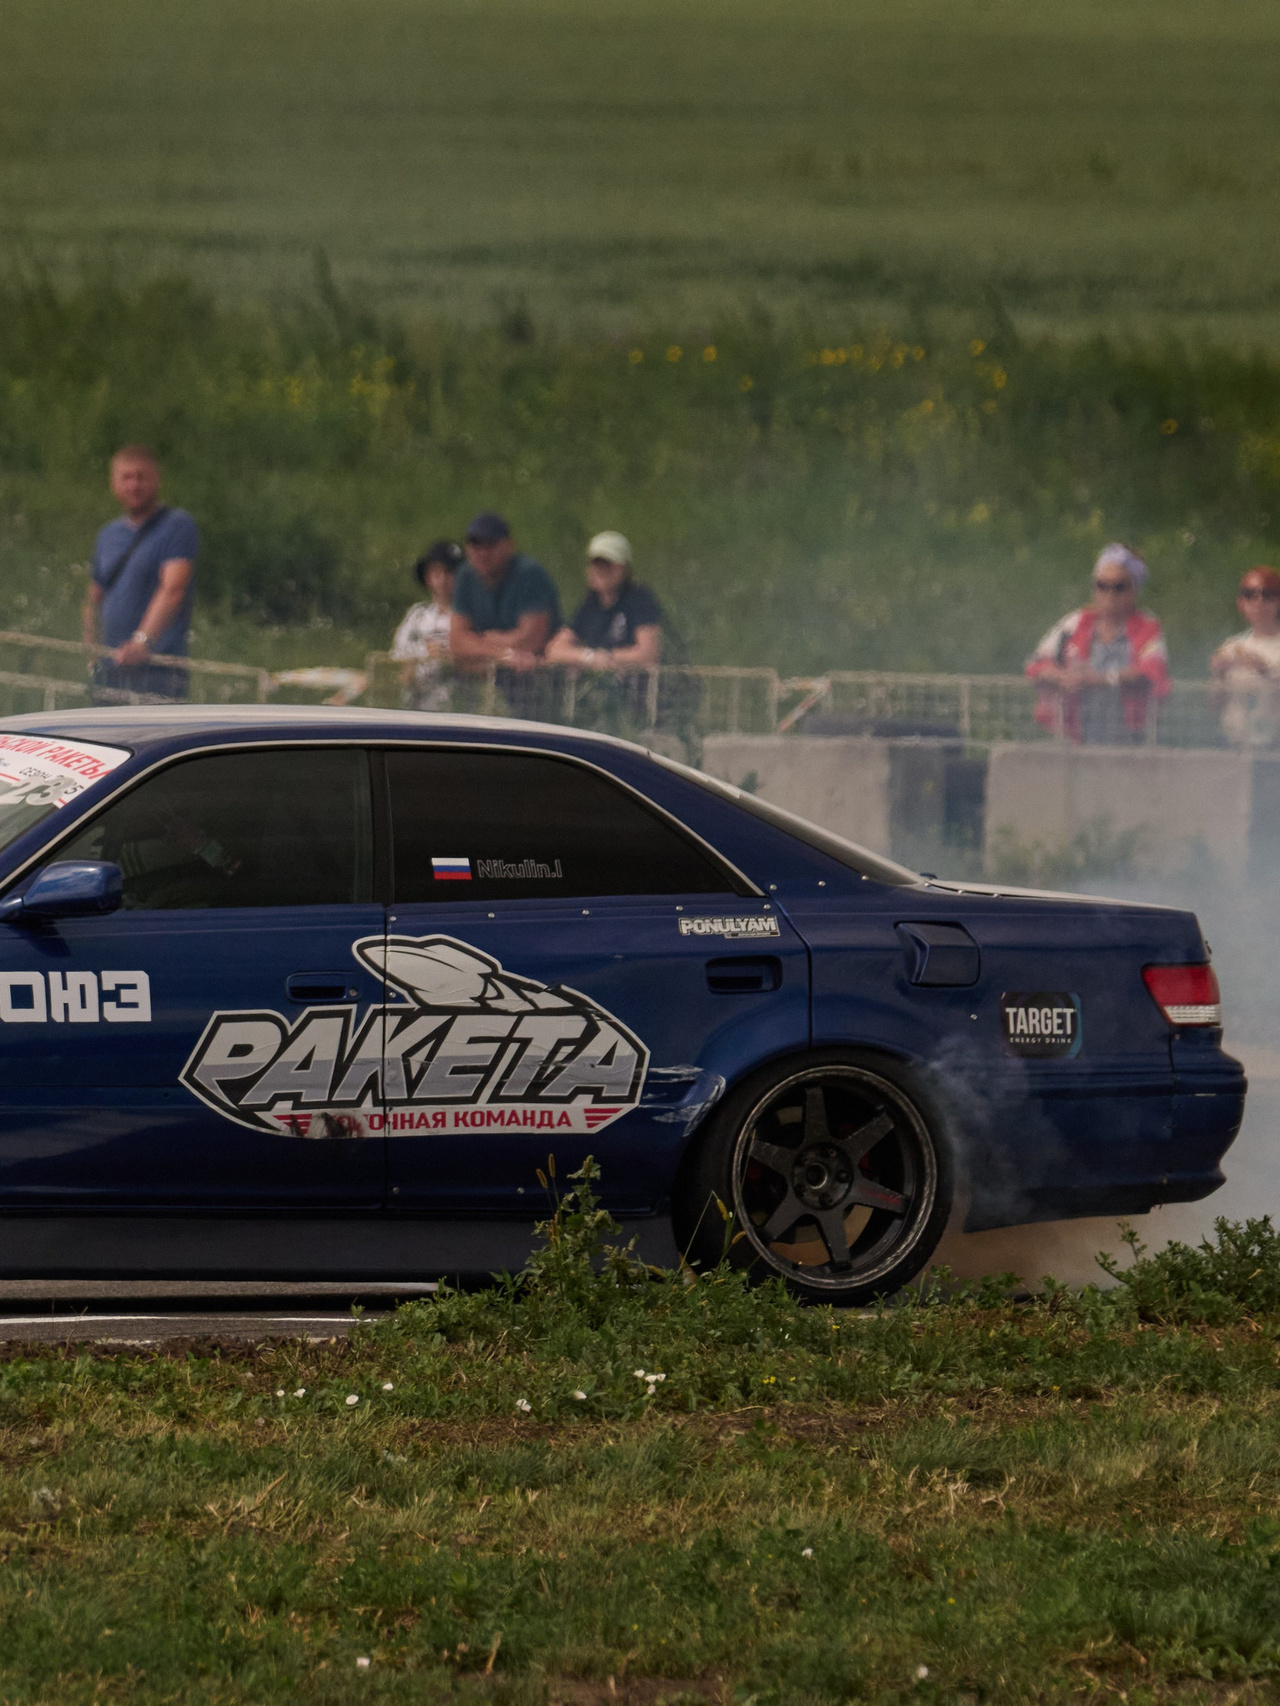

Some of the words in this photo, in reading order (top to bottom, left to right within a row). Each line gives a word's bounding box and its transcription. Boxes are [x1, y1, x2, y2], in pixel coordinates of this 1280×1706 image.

[679, 917, 777, 935] PONULYAM
[1005, 1006, 1075, 1035] TARGET
[1009, 1036, 1041, 1044] ENERGY
[1045, 1036, 1073, 1044] DRINK
[453, 1109, 572, 1129] КОМАНДА
